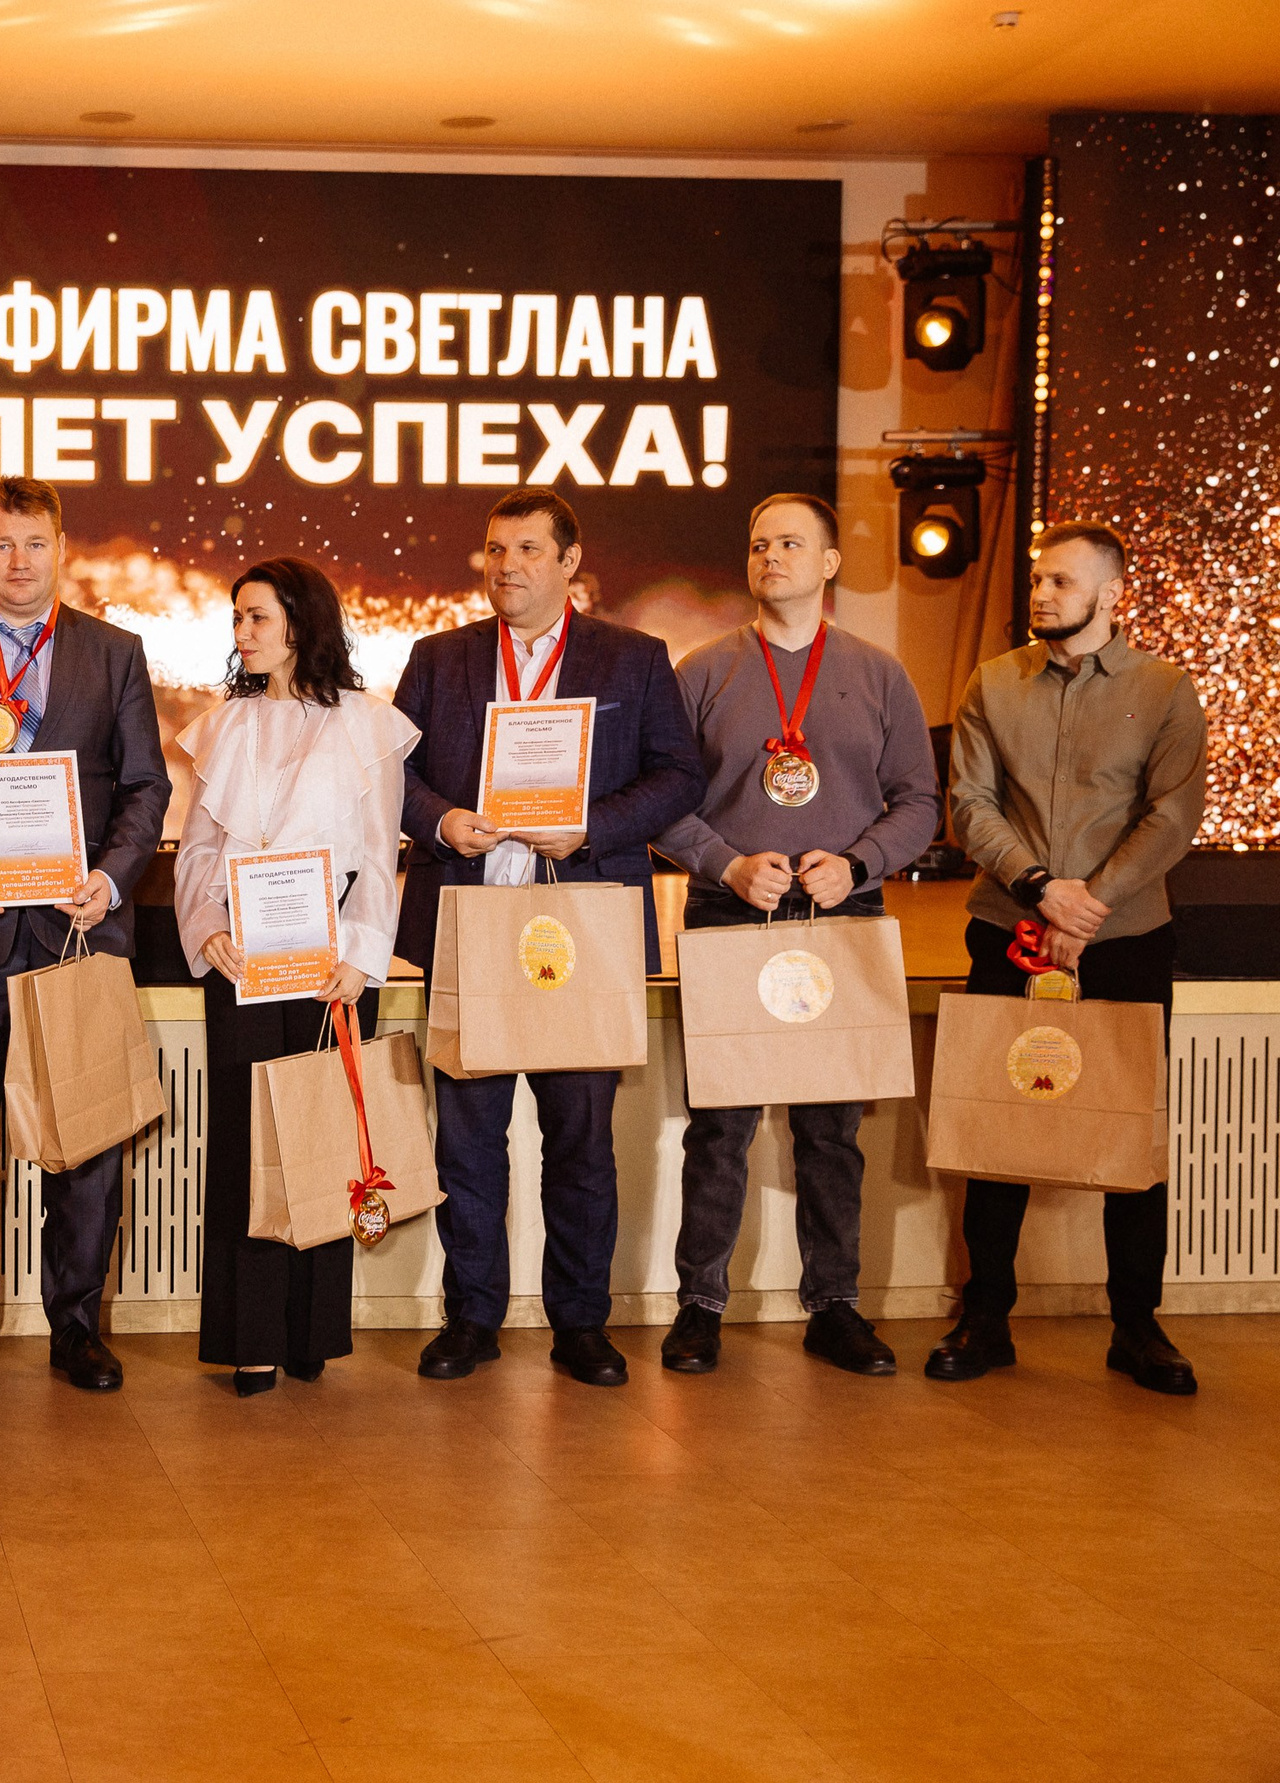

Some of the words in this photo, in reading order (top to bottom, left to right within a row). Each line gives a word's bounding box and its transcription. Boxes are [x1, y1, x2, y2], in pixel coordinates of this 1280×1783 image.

[310, 289, 718, 379] СВЕТЛАНА
[202, 399, 730, 489] УСПЕХА!
[508, 718, 573, 726] БЛАГОДАРСТВЕННОЕ
[249, 867, 315, 880] БЛАГОДАРСТВЕННОЕ
[268, 878, 296, 887] ПИСЬМО
